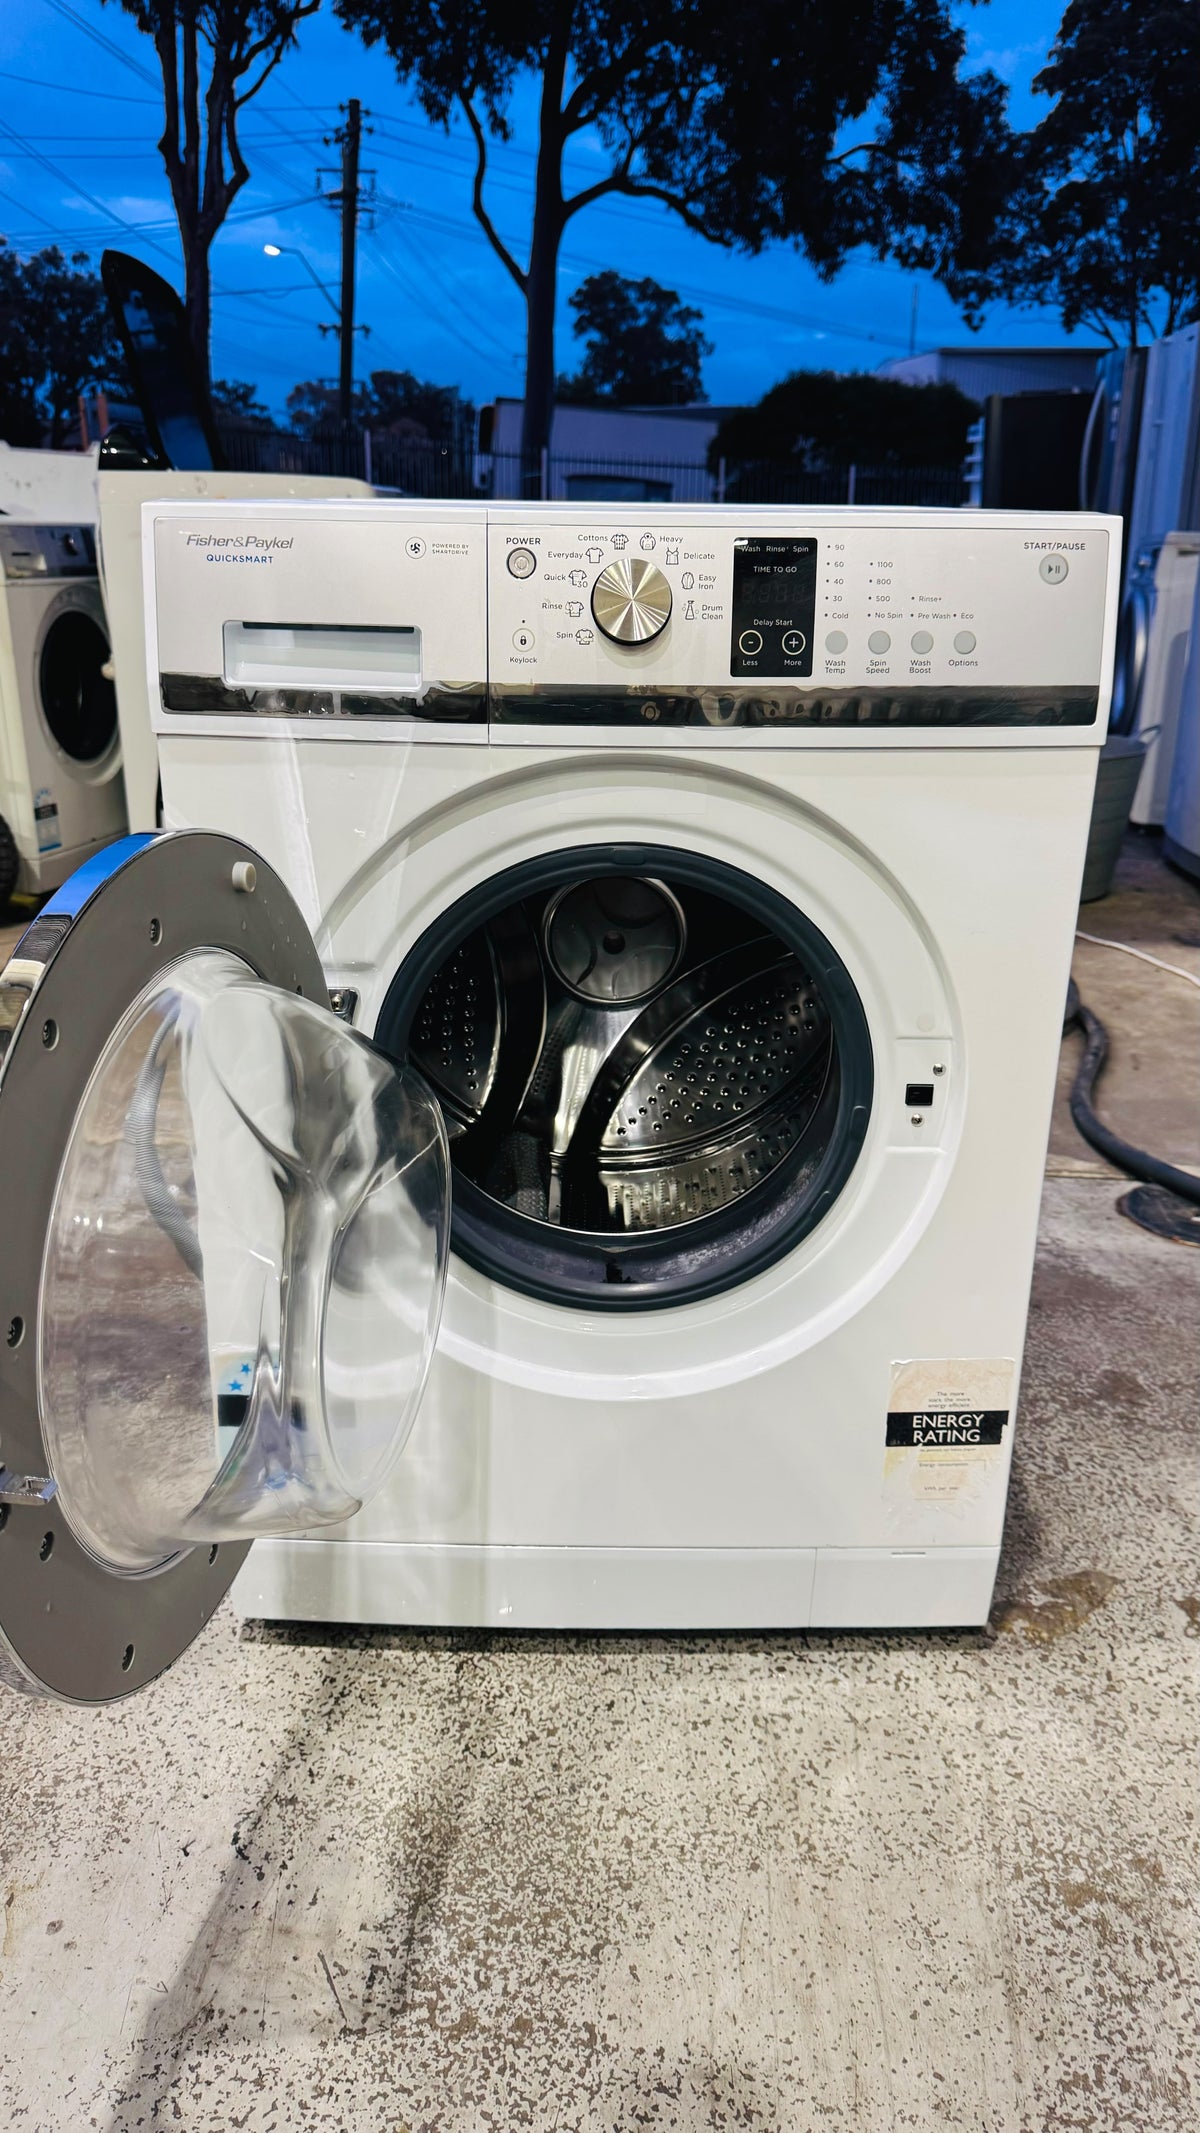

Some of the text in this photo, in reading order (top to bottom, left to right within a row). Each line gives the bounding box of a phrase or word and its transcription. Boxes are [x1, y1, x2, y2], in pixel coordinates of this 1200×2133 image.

[186, 534, 294, 551] Fisher&Paykel
[506, 537, 541, 545] POWER
[659, 536, 684, 544] Heavy
[792, 546, 809, 554] Spin
[1024, 542, 1086, 550] START/PAUSE
[206, 554, 274, 564] QUICKSMART
[547, 551, 584, 560] Everyday
[684, 552, 716, 560] Delicate
[544, 573, 566, 582] Quick
[698, 574, 717, 582] Easy
[887, 612, 903, 620] Spin
[753, 619, 774, 627] Delay
[556, 631, 573, 640] Spin
[870, 659, 887, 668] Spin
[948, 659, 978, 668] Options
[866, 667, 890, 675] Speed
[912, 1414, 984, 1429] ENERGY
[912, 1429, 980, 1444] RATING
